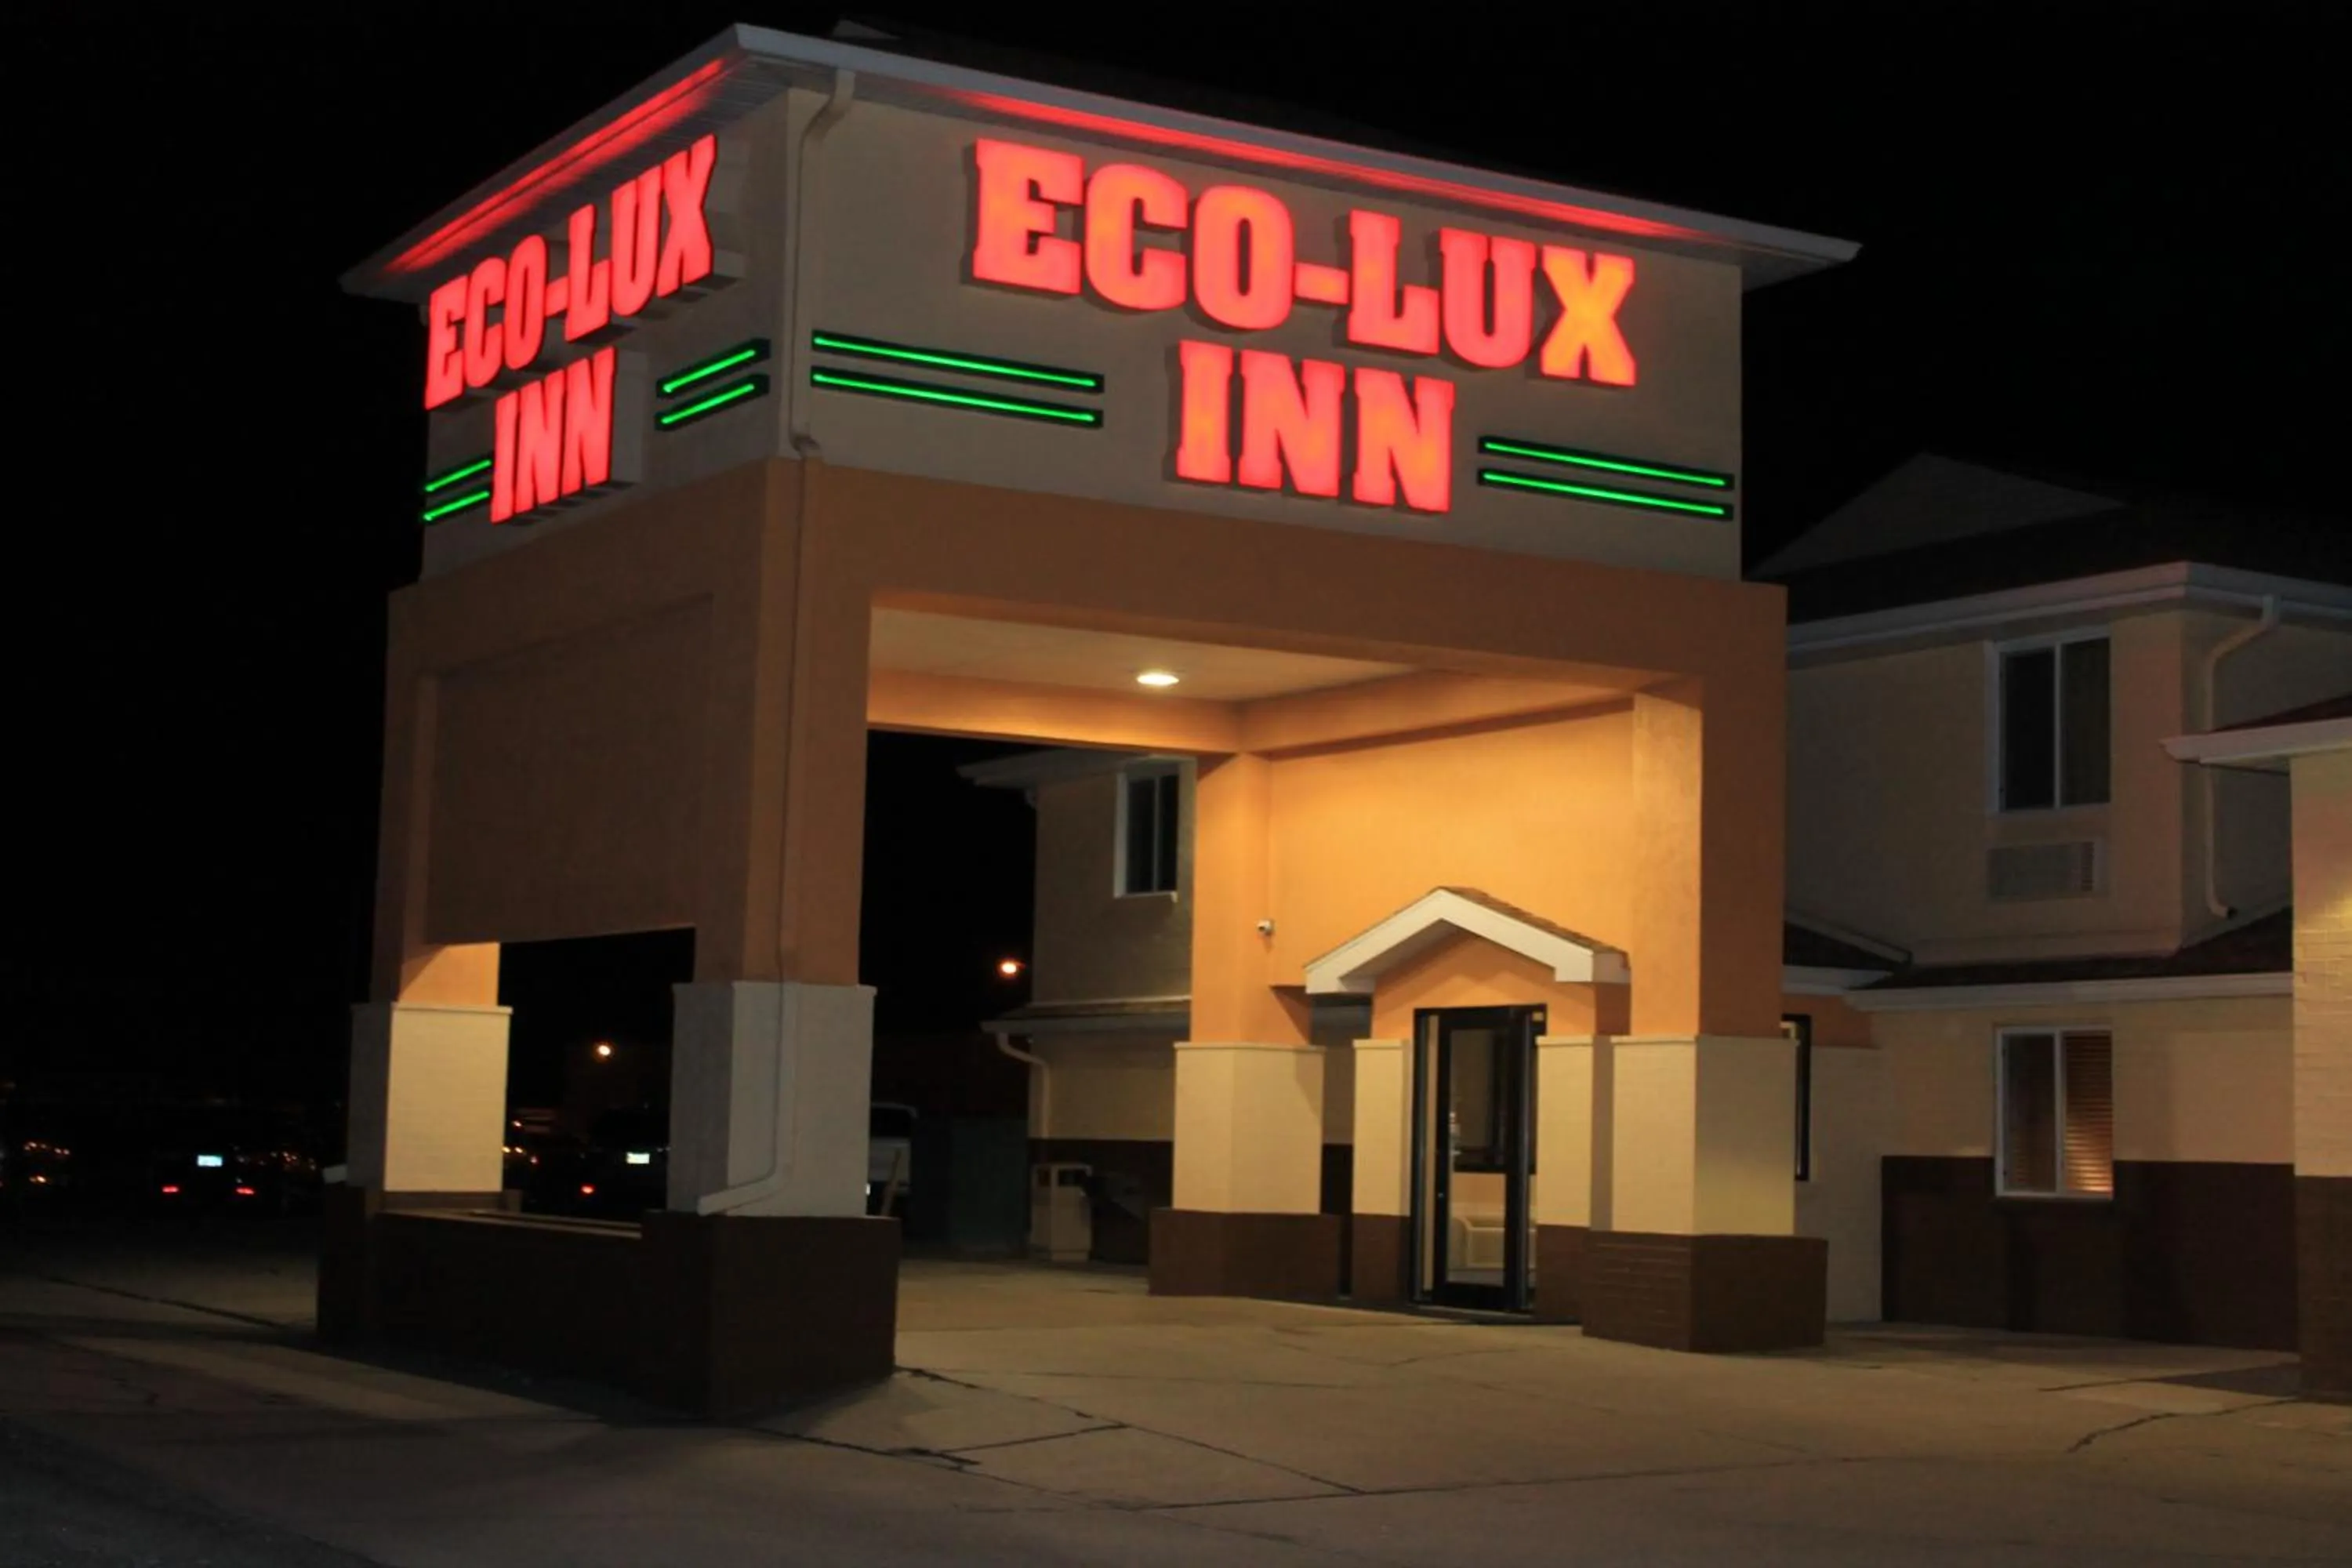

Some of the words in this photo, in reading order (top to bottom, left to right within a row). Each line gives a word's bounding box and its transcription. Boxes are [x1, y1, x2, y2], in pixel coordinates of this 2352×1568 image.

[425, 133, 717, 410] ECO-LUX
[973, 138, 1635, 387] ECO-LUX
[491, 347, 615, 524] INN
[1177, 340, 1454, 513] INN
